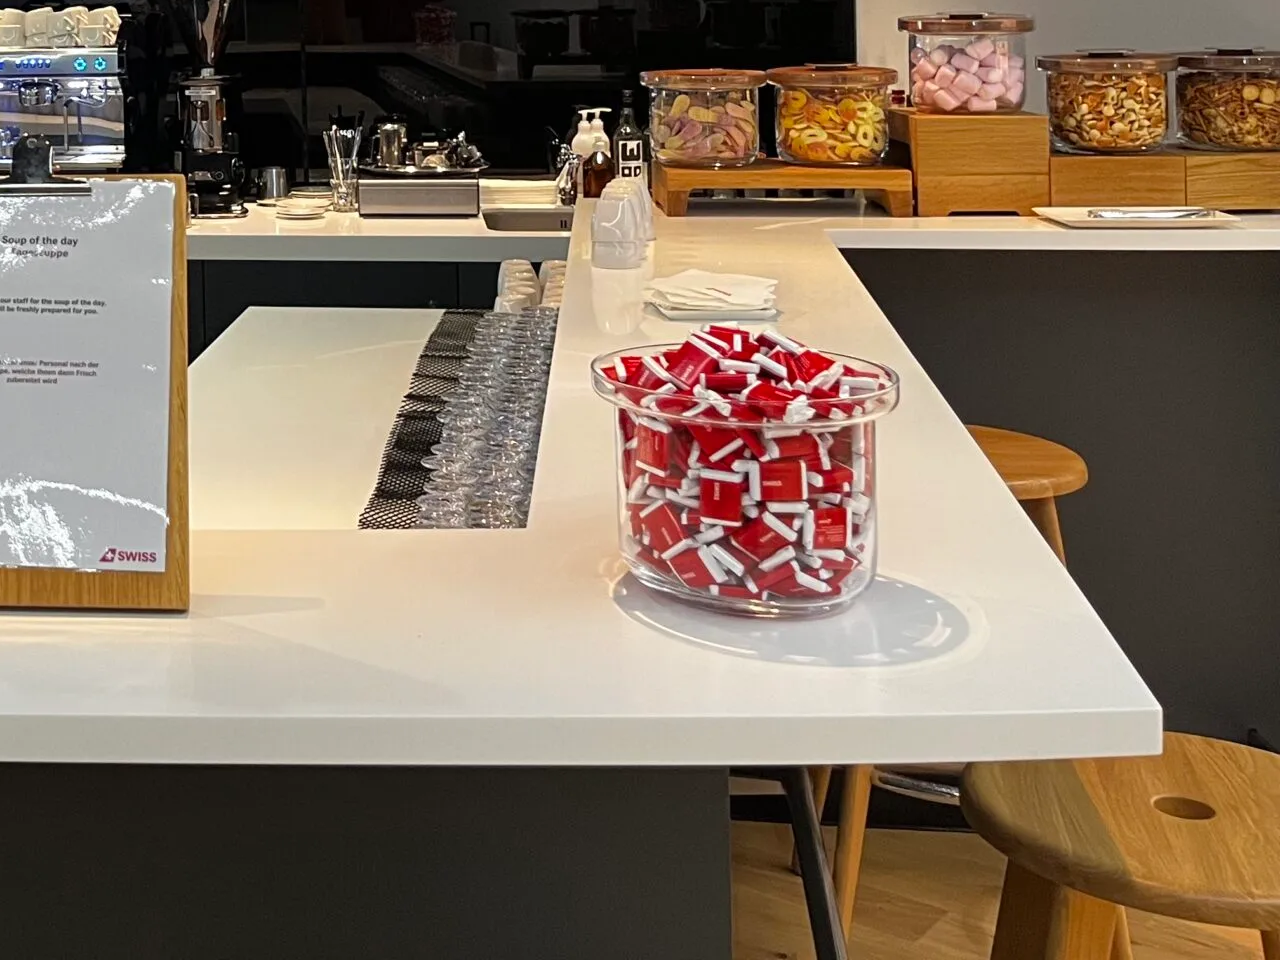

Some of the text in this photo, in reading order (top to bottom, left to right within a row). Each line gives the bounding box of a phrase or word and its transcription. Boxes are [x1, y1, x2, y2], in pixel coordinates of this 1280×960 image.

[2, 235, 79, 247] Soup of the day
[16, 305, 39, 314] freshly
[40, 307, 71, 315] prepared
[83, 308, 99, 316] you.
[39, 360, 69, 368] Personal
[117, 550, 158, 564] SWISS
